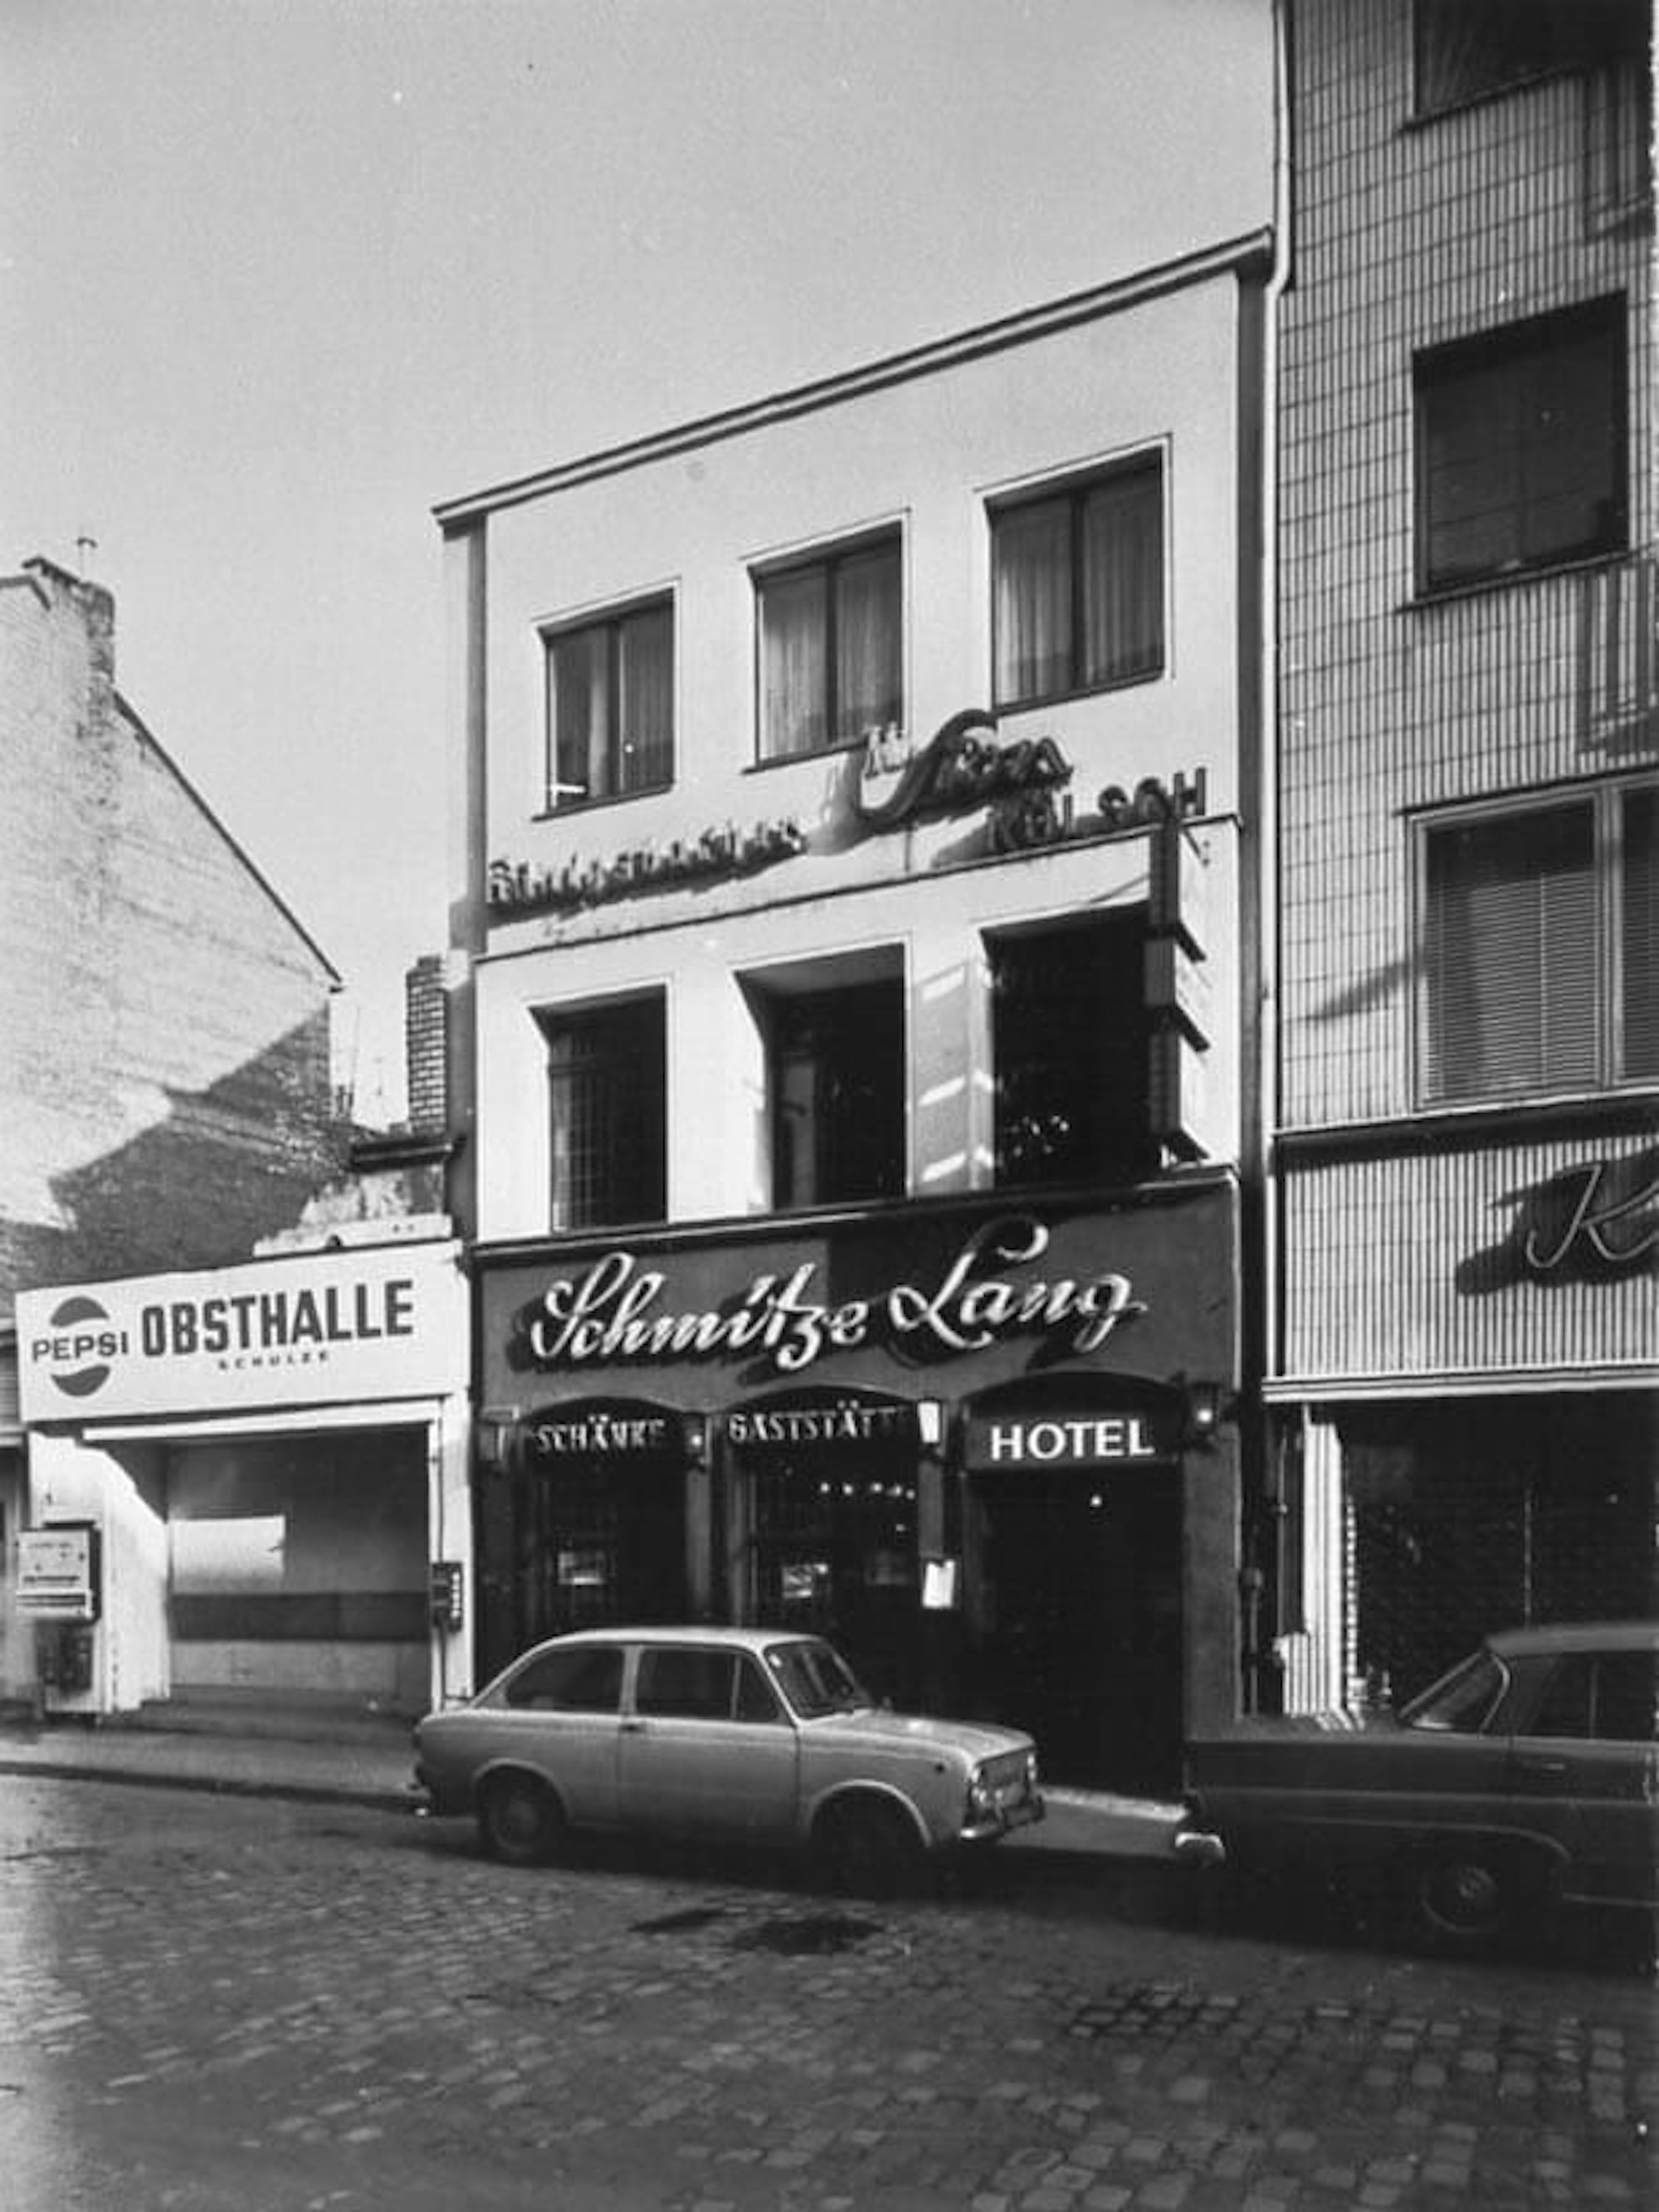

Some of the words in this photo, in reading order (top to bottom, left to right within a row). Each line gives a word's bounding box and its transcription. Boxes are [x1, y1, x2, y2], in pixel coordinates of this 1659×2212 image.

[531, 1251, 871, 1371] Schmitze
[889, 1217, 1149, 1352] Lang
[142, 1280, 413, 1358] OBSTHALLE
[32, 1331, 129, 1362] PEPSI
[217, 1349, 329, 1371] SCHULZE
[991, 1419, 1157, 1462] HOTEL
